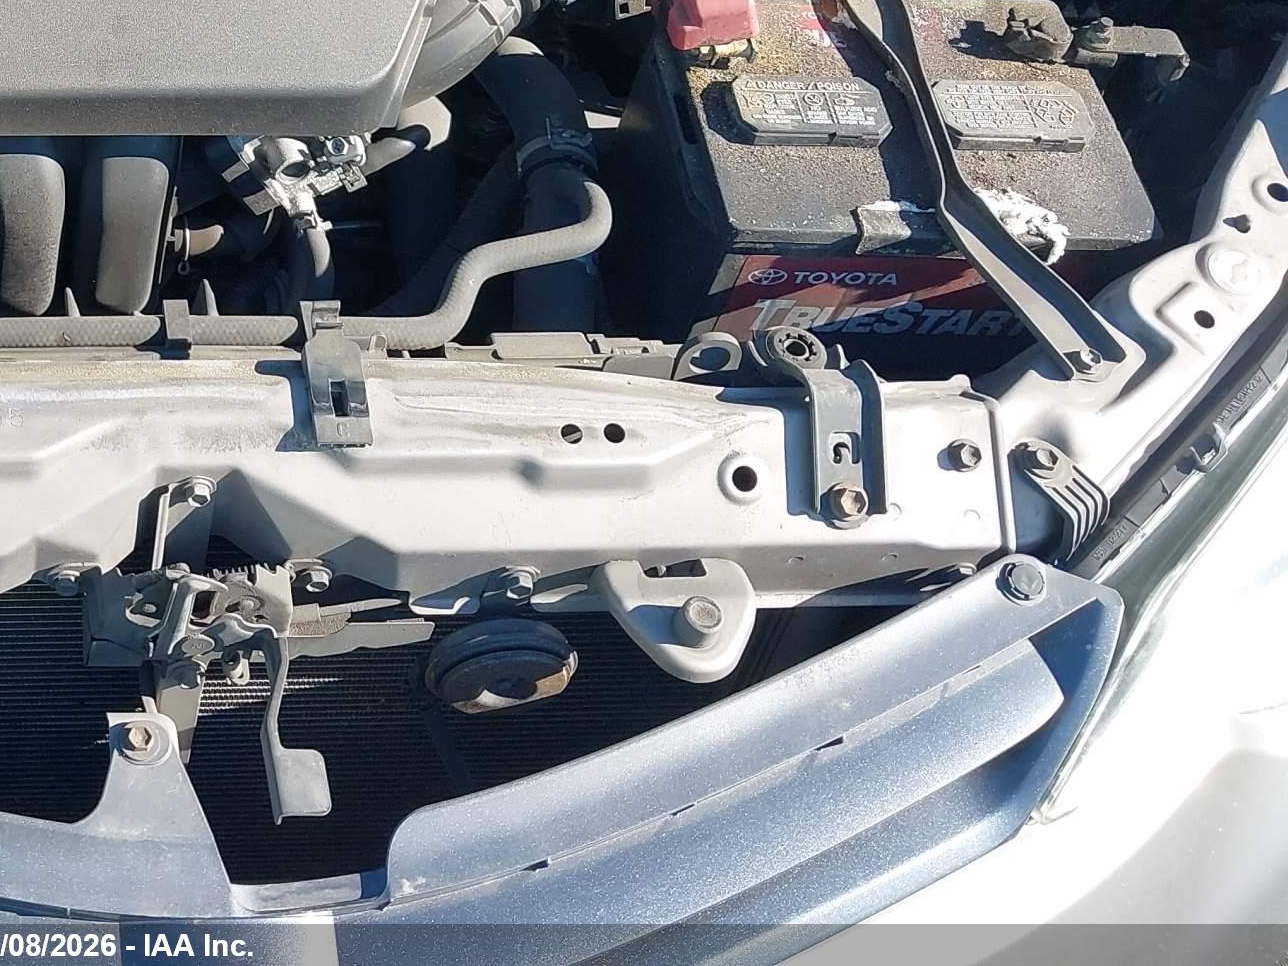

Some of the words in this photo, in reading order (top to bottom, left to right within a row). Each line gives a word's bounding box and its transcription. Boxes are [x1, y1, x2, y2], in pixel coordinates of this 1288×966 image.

[758, 80, 808, 91] DANGER
[816, 81, 860, 92] POISON
[793, 271, 898, 285] TOYOTA
